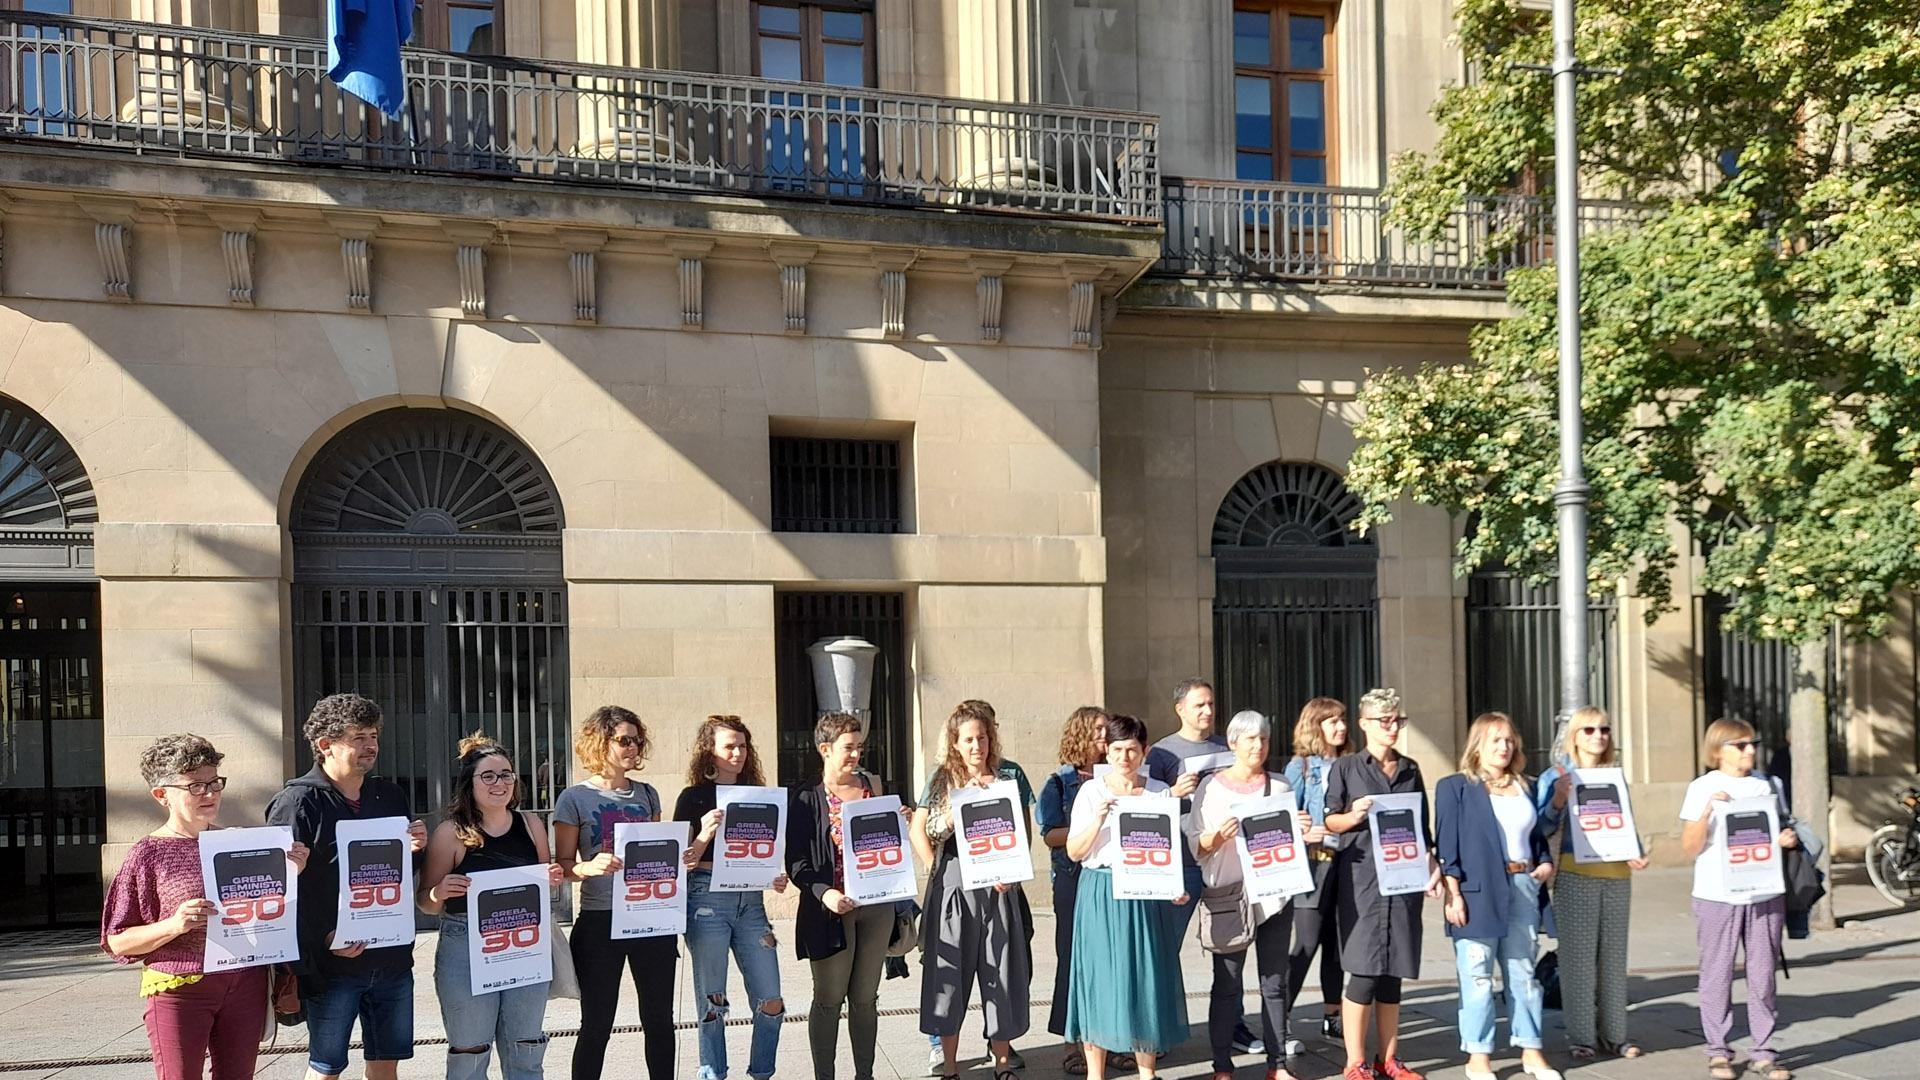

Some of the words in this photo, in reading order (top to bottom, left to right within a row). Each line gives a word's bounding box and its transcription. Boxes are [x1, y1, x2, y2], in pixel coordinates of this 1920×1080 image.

[965, 821, 1012, 833] FEMINISTA
[973, 817, 1003, 826] GREBA
[1580, 813, 1623, 831] 30
[861, 831, 890, 839] GREBA
[966, 826, 1014, 838] OROKORRA
[854, 835, 898, 846] FEMINISTA
[854, 840, 899, 851] OROKORRA
[967, 832, 1016, 855] 30
[724, 840, 775, 859] 30
[1250, 843, 1296, 868] 30
[1382, 842, 1418, 862] 30
[1728, 844, 1771, 864] 30
[855, 847, 902, 870] 30
[1122, 848, 1171, 866] 30
[351, 869, 399, 878] FEMINISTA
[626, 866, 676, 874] FEMINISTA
[626, 872, 676, 880] OROKORRA
[232, 874, 272, 884] GREBA
[351, 875, 400, 884] OROKORRA
[221, 880, 283, 892] FEMINISTA
[625, 879, 677, 901] 30
[222, 888, 284, 899] OROKORRA
[350, 883, 401, 908] 30
[221, 896, 285, 925] 30
[491, 908, 527, 917] GREBA
[481, 912, 537, 925] FEMINISTA
[481, 918, 538, 932] OROKORRA
[482, 925, 540, 953] 30
